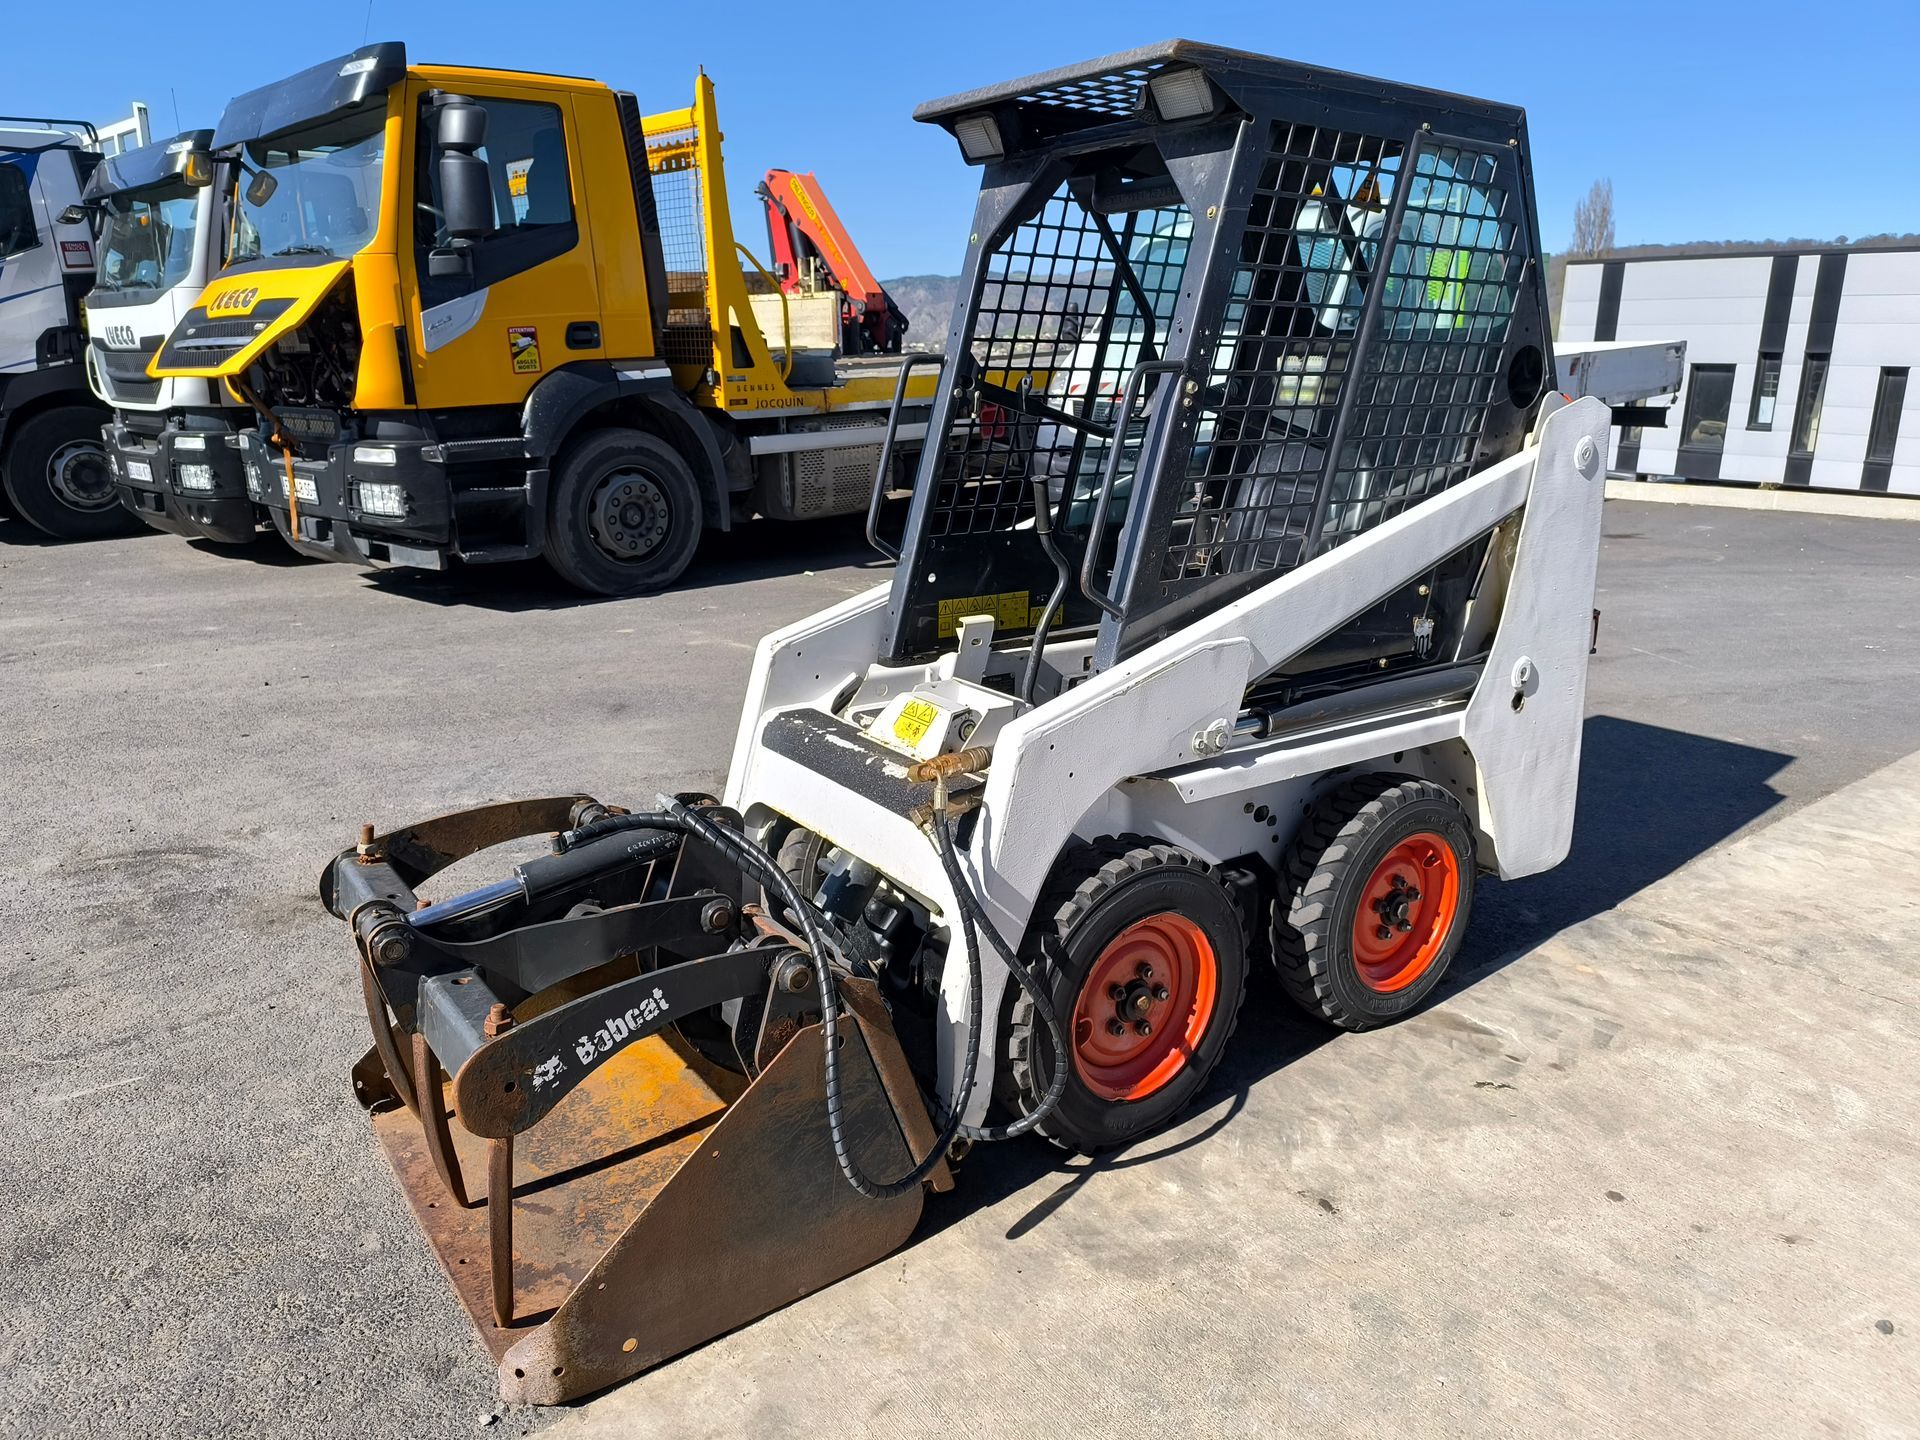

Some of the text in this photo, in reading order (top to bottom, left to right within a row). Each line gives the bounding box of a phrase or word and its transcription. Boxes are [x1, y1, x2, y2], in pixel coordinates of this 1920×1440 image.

[210, 287, 259, 312] IVECO
[105, 325, 136, 346] IVECO
[736, 383, 776, 392] BENNES
[575, 987, 670, 1066] Bobcat
